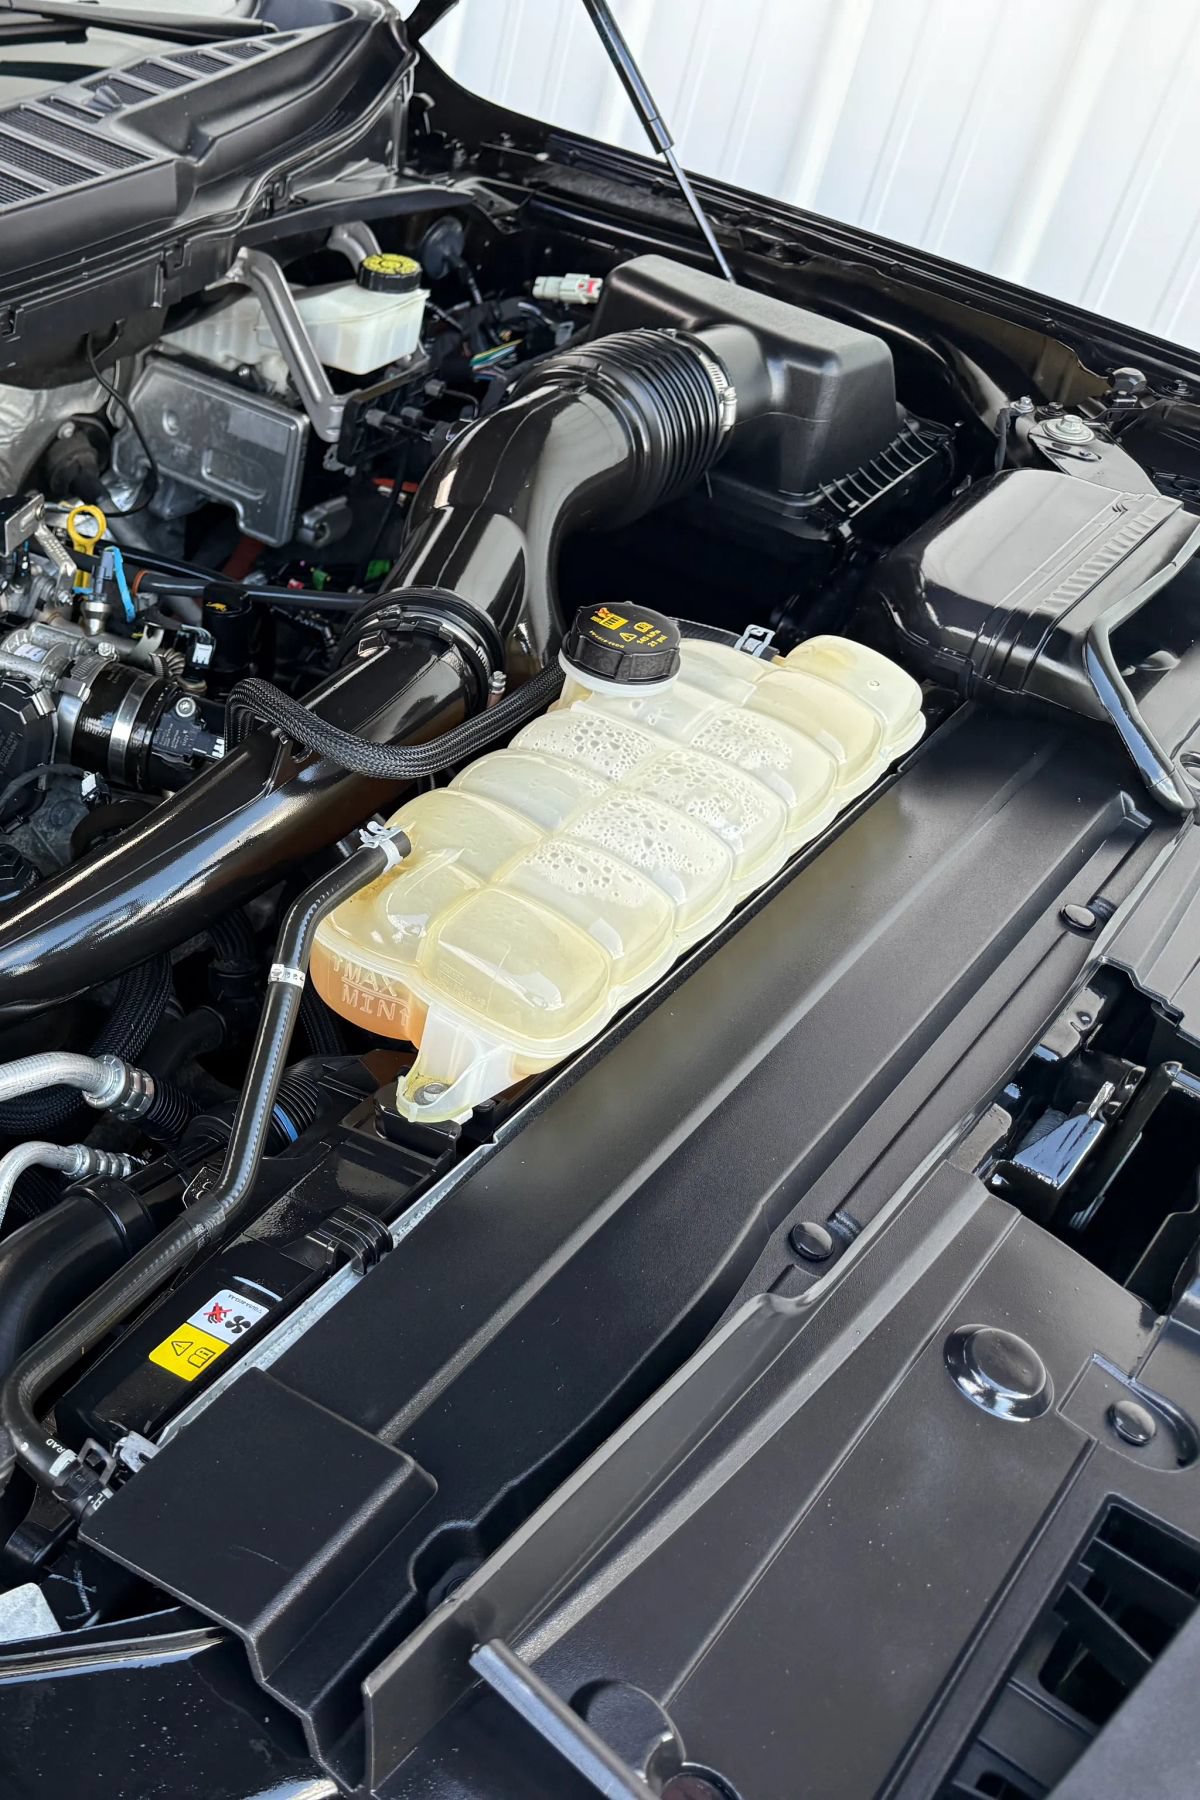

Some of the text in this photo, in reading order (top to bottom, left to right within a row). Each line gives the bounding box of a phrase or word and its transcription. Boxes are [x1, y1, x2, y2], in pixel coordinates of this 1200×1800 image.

[343, 962, 398, 997] MAX
[341, 984, 397, 1021] MIN
[45, 1438, 67, 1454] RAD
